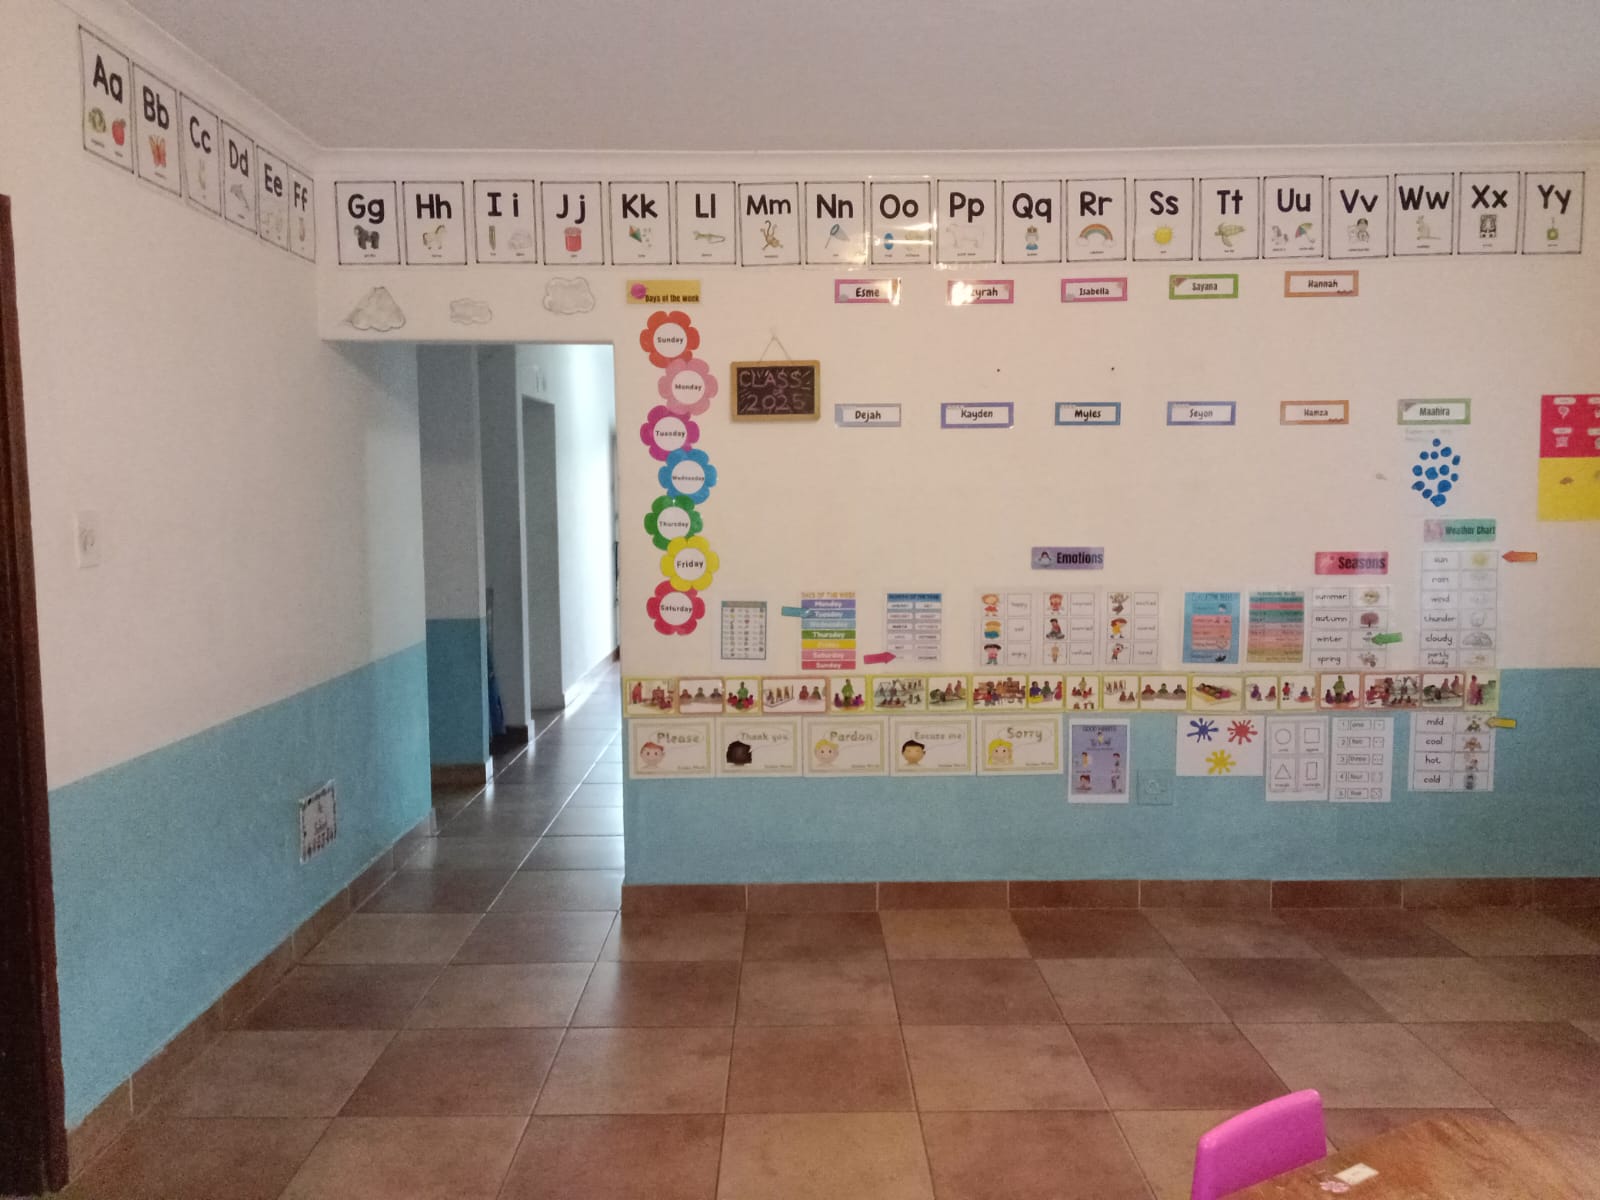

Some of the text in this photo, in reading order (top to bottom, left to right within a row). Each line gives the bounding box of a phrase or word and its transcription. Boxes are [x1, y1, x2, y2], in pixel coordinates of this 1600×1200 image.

[92, 55, 123, 104] Aa
[142, 85, 169, 131] Bb
[190, 115, 211, 154] Cc
[228, 139, 248, 178] Dd
[264, 163, 283, 197] Ee
[293, 181, 308, 211] Ff
[1079, 191, 1112, 217] Rr
[1150, 190, 1179, 216] Ss
[1217, 190, 1243, 215] Tt
[1277, 188, 1311, 213] Uu
[1340, 189, 1379, 214] Vv
[1399, 185, 1450, 211] Ww
[1471, 184, 1508, 209] Xx
[1538, 184, 1572, 215] Yy
[347, 193, 385, 224] Gg
[416, 194, 452, 220] Hh
[621, 194, 658, 219] Kk
[746, 194, 791, 217] Mm
[817, 194, 853, 219] Nn
[879, 194, 919, 219] Oo
[950, 192, 985, 223] Pp
[1012, 193, 1052, 224] Qq
[855, 287, 880, 298] Esme
[1079, 287, 1110, 296] Isabella
[1307, 279, 1338, 289] Hannah
[645, 295, 661, 304] Days
[657, 336, 684, 344] Sunday
[740, 369, 802, 388] CLASS
[675, 384, 702, 392] Monday
[747, 394, 806, 411] 2025
[855, 410, 881, 422] Dejah
[961, 409, 993, 421] Kayden
[1074, 409, 1102, 421] Myles
[1304, 408, 1328, 416] Hamza
[656, 430, 686, 438] Tuesday
[1476, 526, 1496, 534] Chart
[676, 560, 704, 569] Friday
[1056, 552, 1104, 564] Emotions
[1338, 556, 1386, 570] Seasons
[660, 604, 693, 614] Saturday
[1426, 634, 1452, 646] cloudy
[1318, 654, 1341, 665] spring
[657, 732, 700, 744] Please
[830, 732, 872, 742] Pardon
[1007, 728, 1042, 742] Sorry
[1424, 775, 1441, 784] cold
